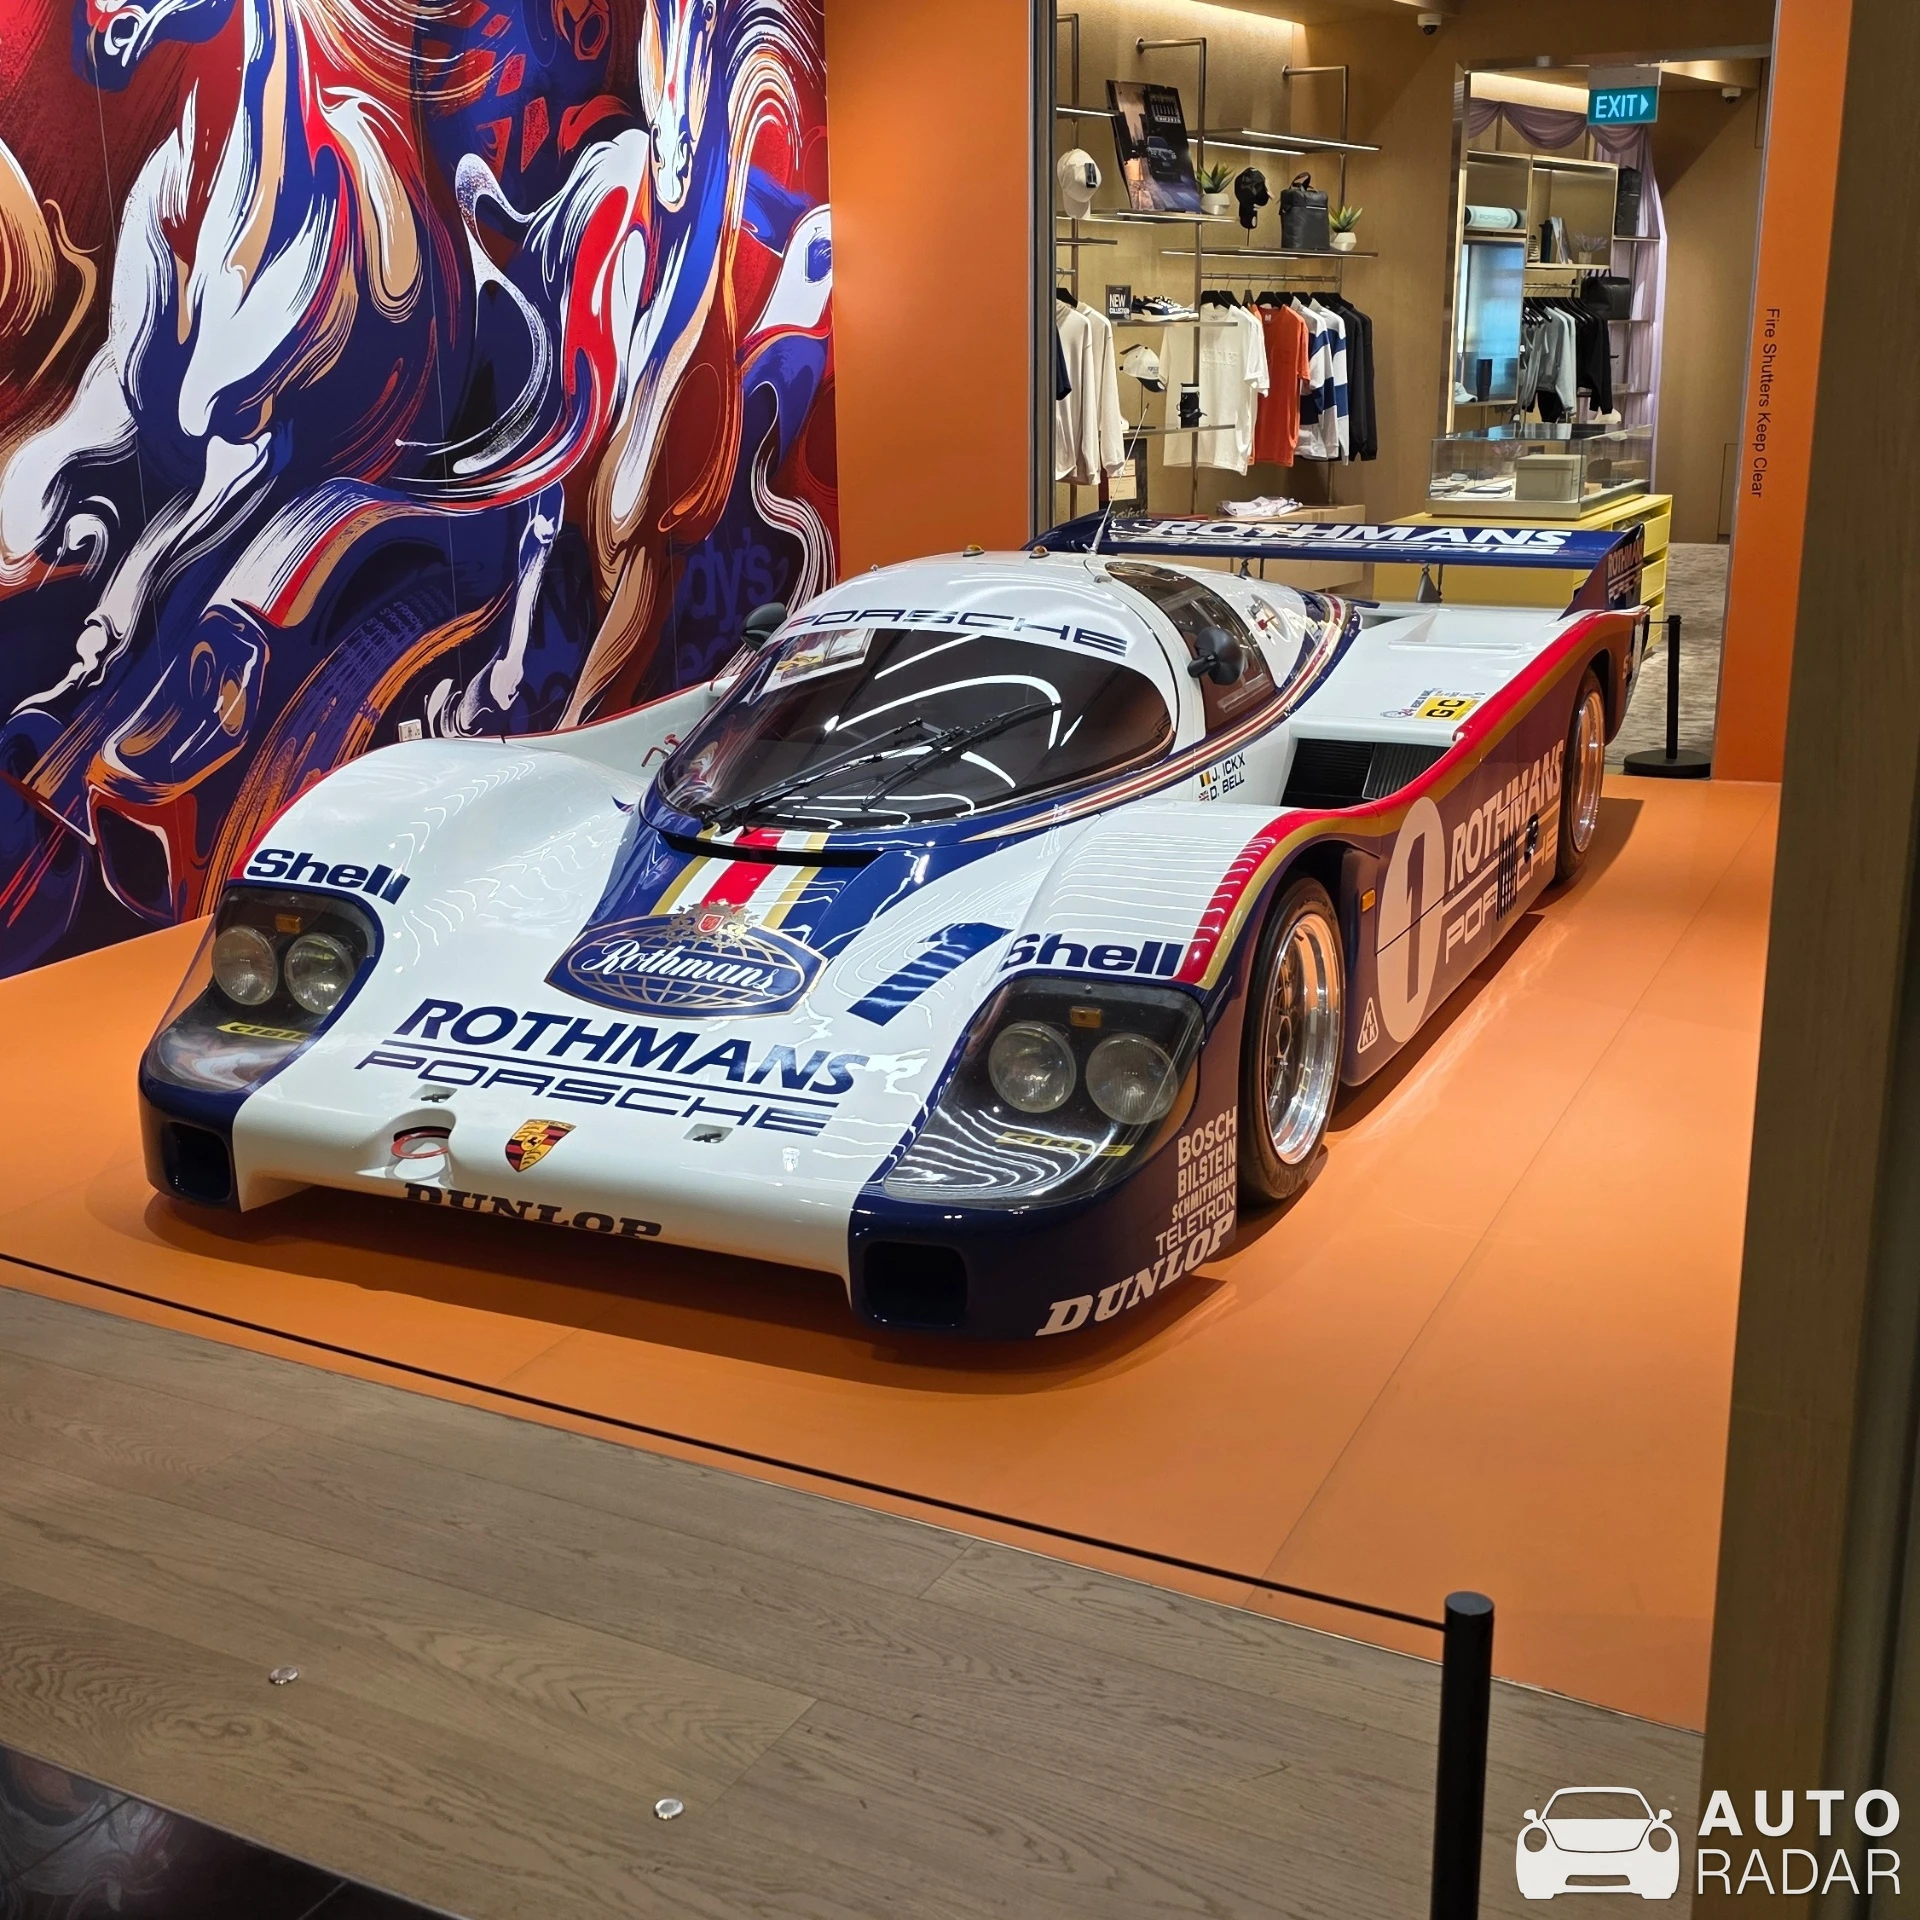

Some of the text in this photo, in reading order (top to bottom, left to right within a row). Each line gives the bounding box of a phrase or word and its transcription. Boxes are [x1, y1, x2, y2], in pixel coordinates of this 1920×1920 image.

[1595, 94, 1638, 119] EXIT
[1110, 294, 1126, 307] NEW
[1751, 309, 1780, 498] Fire Shutters Keep Clear
[1149, 520, 1572, 545] ROTHMANS
[779, 609, 1128, 657] PORSCHE
[1210, 771, 1245, 801] D. BELL
[1212, 752, 1245, 782] J. ICKX
[1449, 740, 1564, 892] ROTHMANS
[246, 848, 411, 905] Shell
[582, 939, 781, 998] Rothmans
[1000, 933, 1185, 977] Shell
[393, 998, 871, 1095] ROTHMANS
[354, 1050, 835, 1137] PORSCHE
[1178, 1106, 1237, 1167] BOSCH
[1172, 1166, 1236, 1223] SCHMITTHELM
[1178, 1136, 1237, 1198] BILSTEIN
[402, 1182, 662, 1238] DUNLOP
[1156, 1185, 1236, 1256] TELETRON
[1035, 1209, 1235, 1337] DUNLOP
